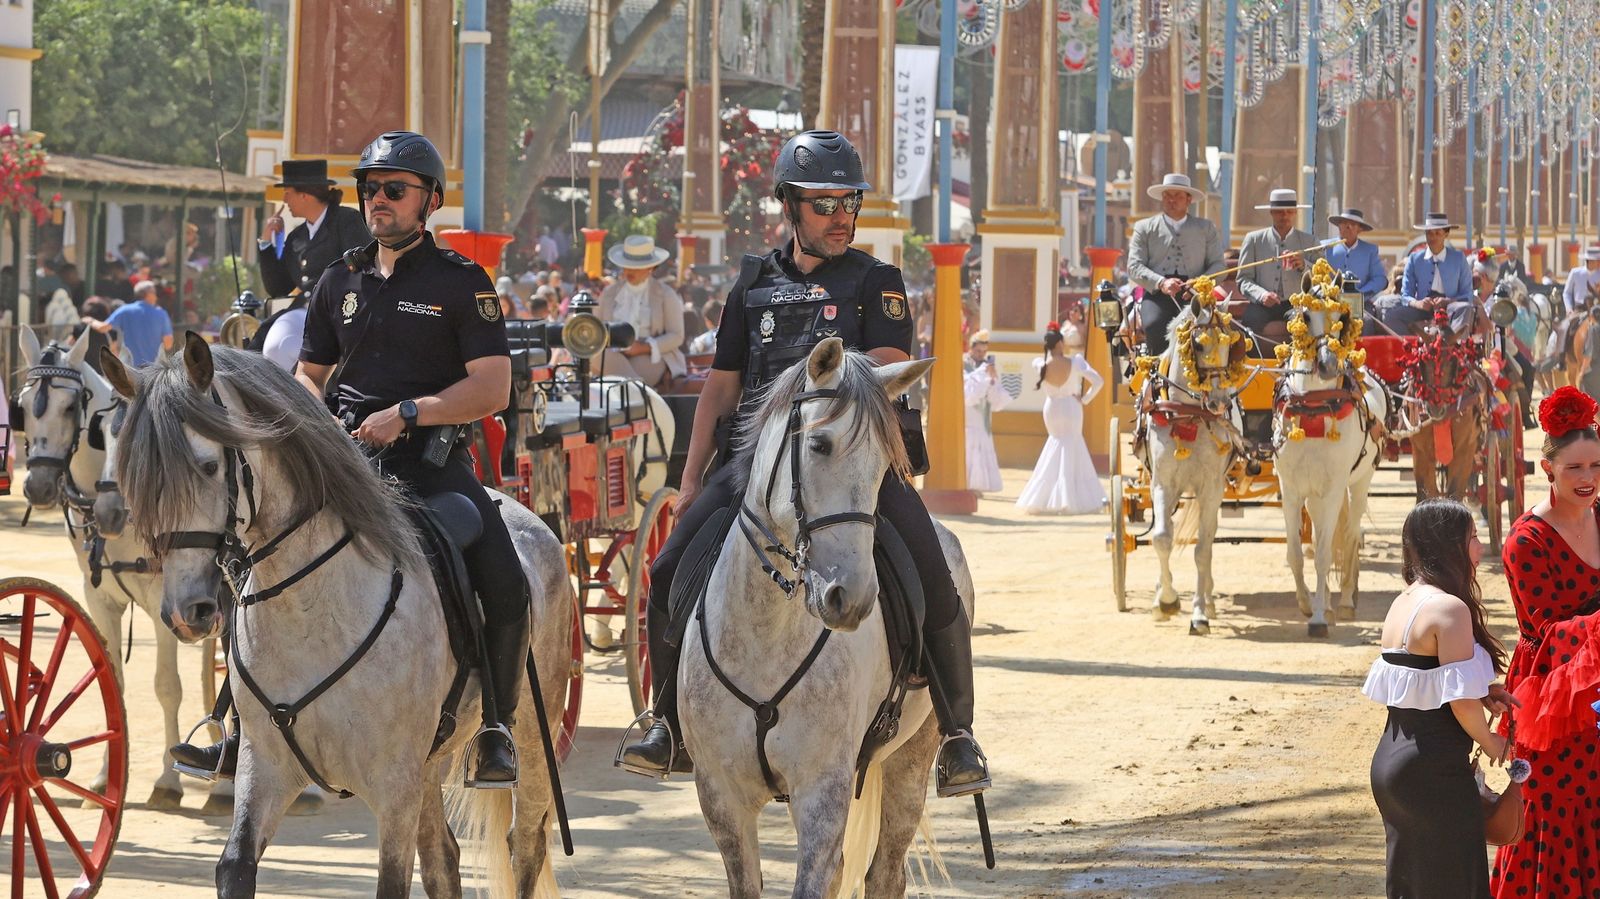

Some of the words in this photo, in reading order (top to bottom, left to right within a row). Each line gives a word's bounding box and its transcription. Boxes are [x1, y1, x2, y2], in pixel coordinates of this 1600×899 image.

[895, 70, 910, 180] GONZÁLEZ
[913, 95, 927, 157] BYASS
[770, 292, 824, 303] NACIONAL
[397, 305, 442, 317] NACIONAL
[398, 300, 433, 311] POLICIA
